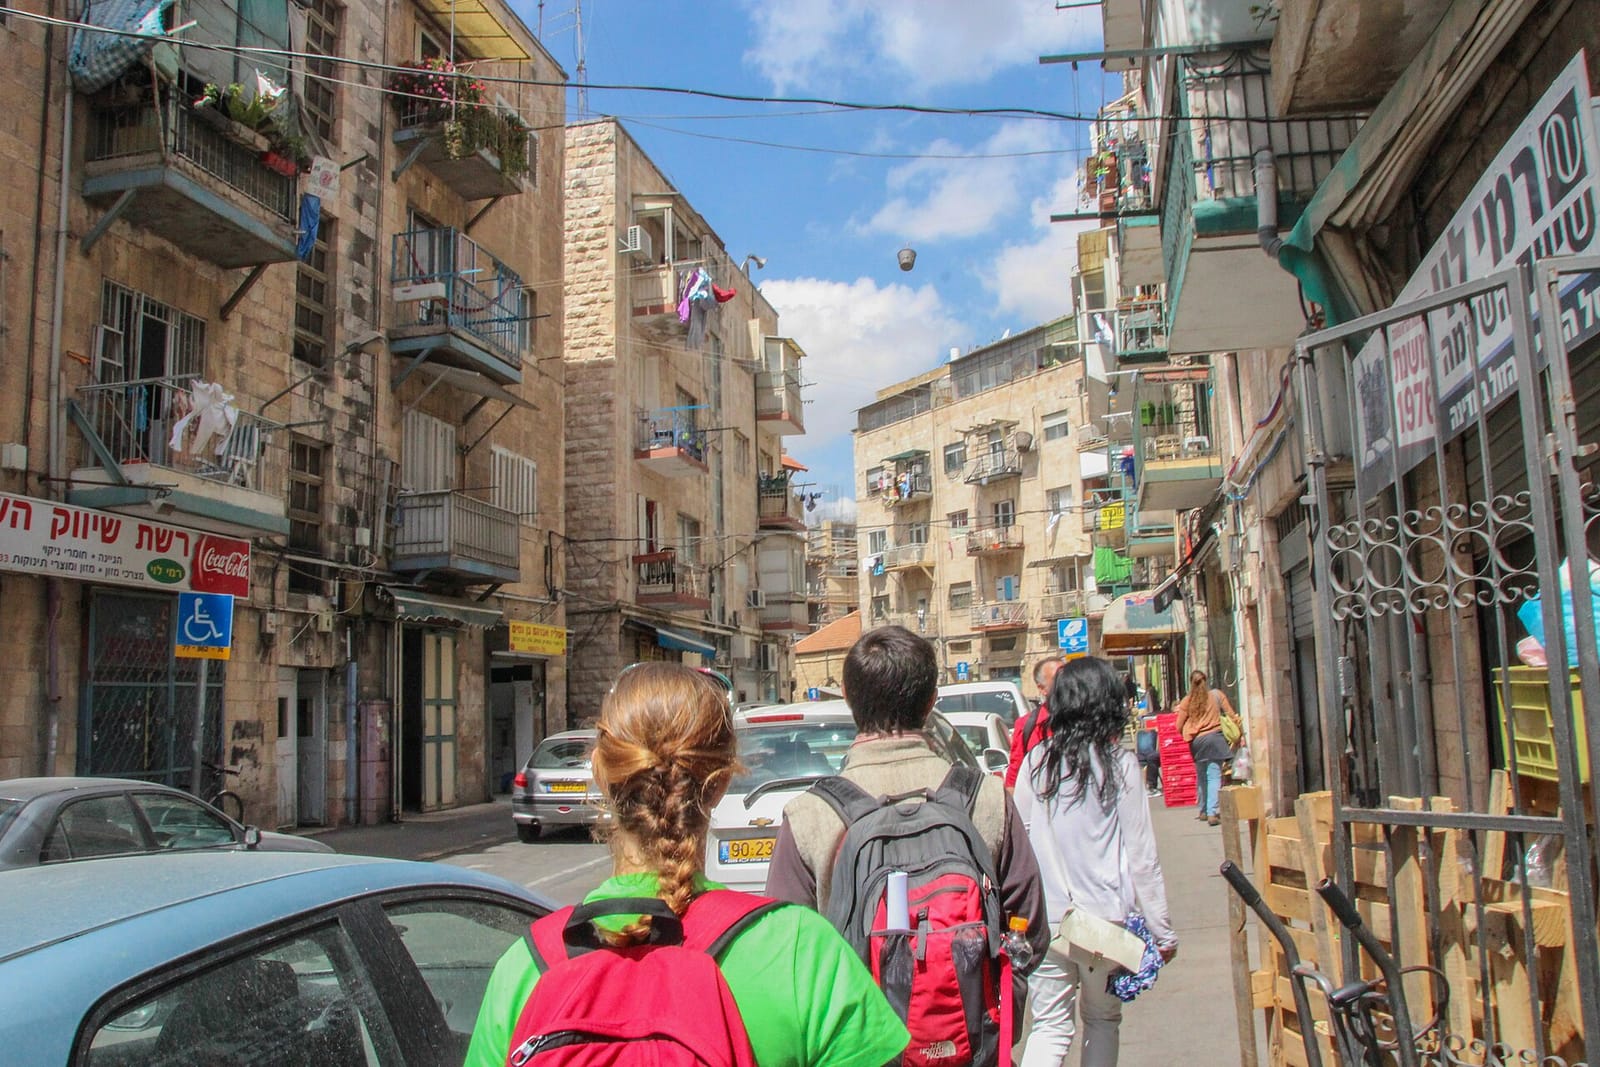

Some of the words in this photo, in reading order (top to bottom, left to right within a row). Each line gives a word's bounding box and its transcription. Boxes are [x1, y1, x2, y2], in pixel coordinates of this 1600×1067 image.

[1471, 146, 1544, 268] רמי
[1430, 224, 1468, 319] לוי
[1440, 287, 1512, 378] השמה
[50, 507, 122, 545] שיווק
[135, 523, 189, 557] רשת
[42, 545, 61, 557] ניקוי
[64, 548, 88, 560] חומרי
[12, 553, 48, 567] תינוקות
[50, 559, 77, 572] ומוצרי
[79, 563, 96, 574] מזון
[104, 566, 120, 578] מזון
[150, 564, 162, 576] לוי
[166, 568, 182, 579] רמי
[122, 569, 145, 581] מצרכי
